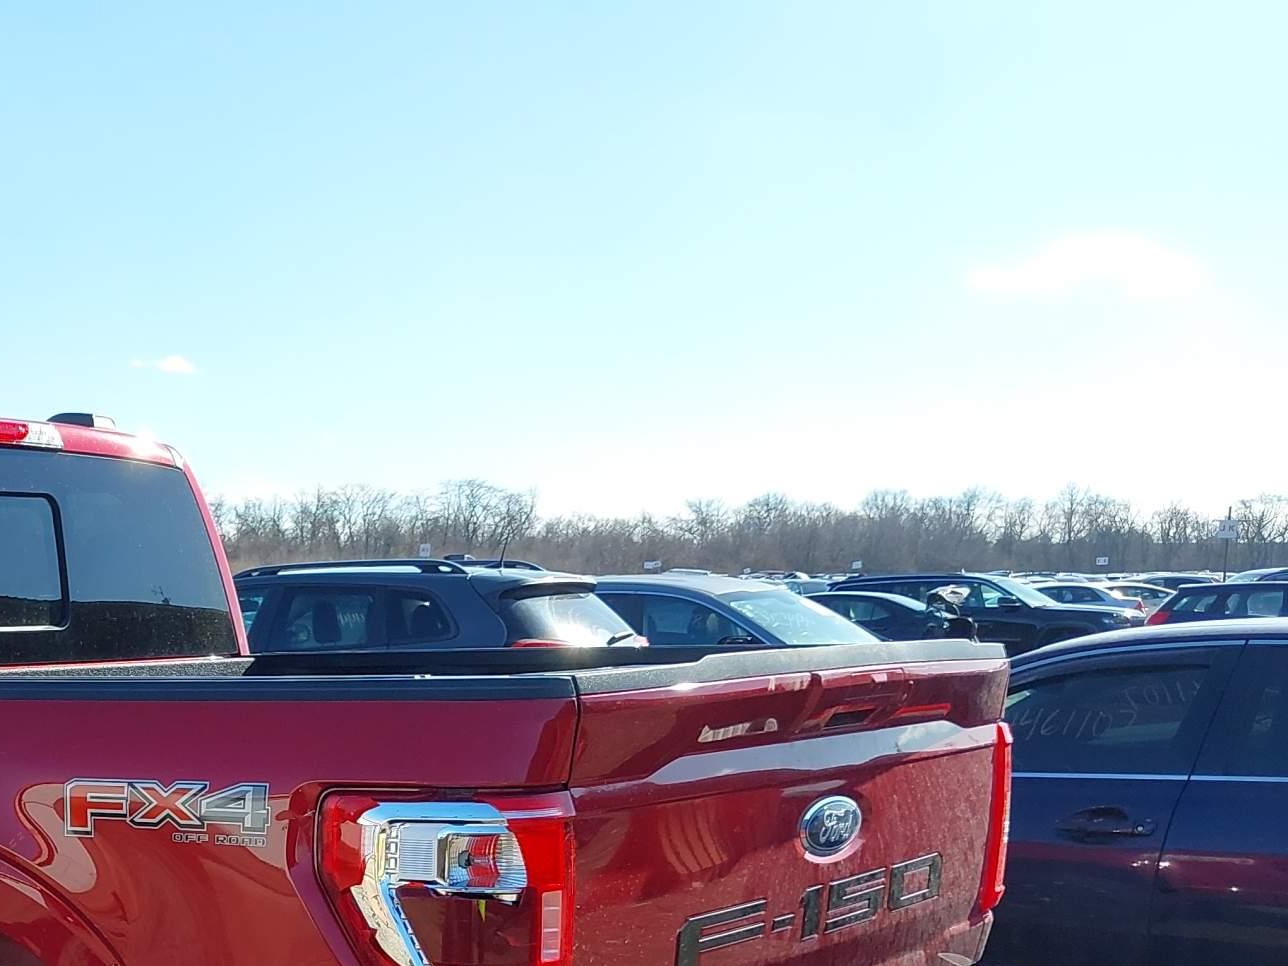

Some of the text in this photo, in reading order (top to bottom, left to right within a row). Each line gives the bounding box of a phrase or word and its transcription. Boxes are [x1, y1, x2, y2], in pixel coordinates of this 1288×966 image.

[64, 778, 271, 837] FX4
[820, 807, 858, 843] Ford
[172, 832, 266, 848] OFF ROAD
